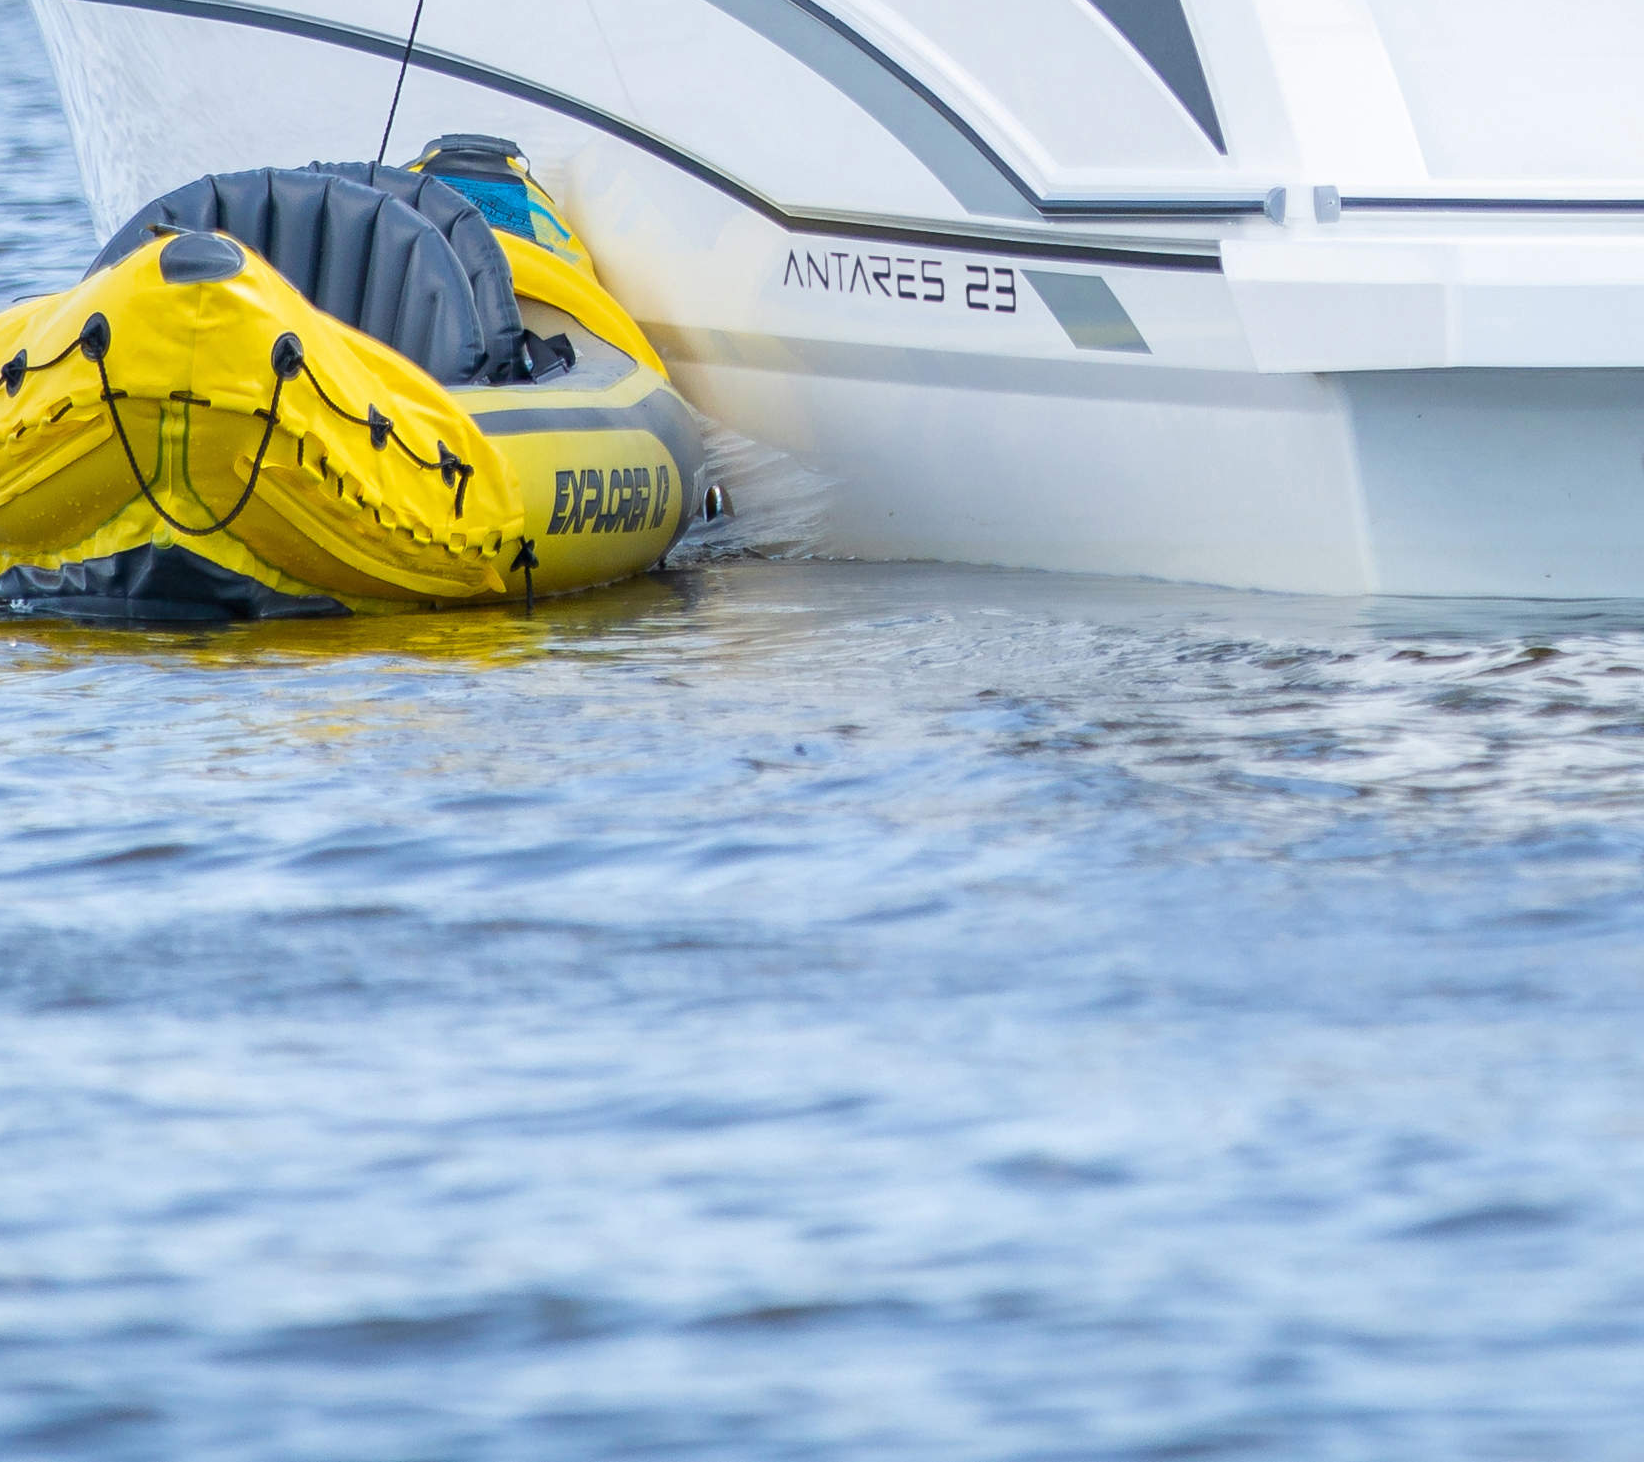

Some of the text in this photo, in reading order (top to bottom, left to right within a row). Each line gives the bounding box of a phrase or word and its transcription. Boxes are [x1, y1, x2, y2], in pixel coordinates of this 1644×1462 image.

[783, 248, 1017, 313] ANTARES 23
[545, 467, 652, 535] EXPLORER
